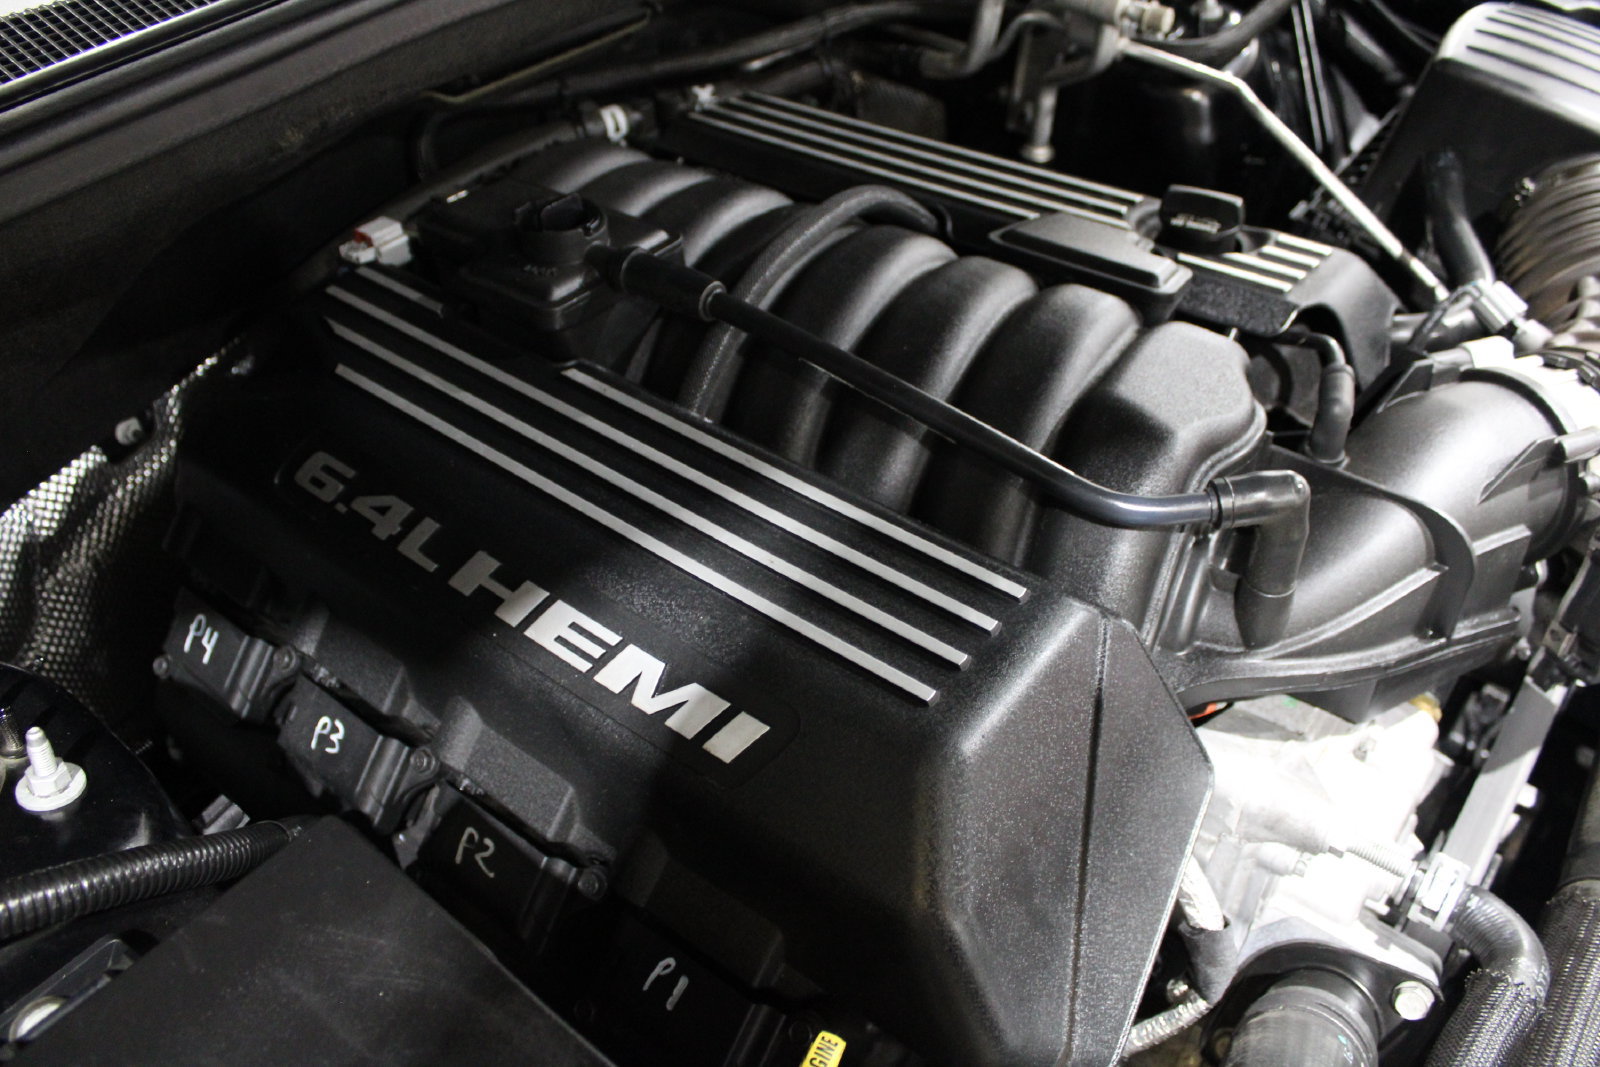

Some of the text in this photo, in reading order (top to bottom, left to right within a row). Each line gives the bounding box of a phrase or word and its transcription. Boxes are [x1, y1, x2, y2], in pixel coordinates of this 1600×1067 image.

[294, 451, 770, 764] 6.4L HEMI
[183, 613, 220, 665] P4
[310, 715, 346, 755] P3
[454, 826, 496, 879] P2
[642, 956, 690, 1012] P1
